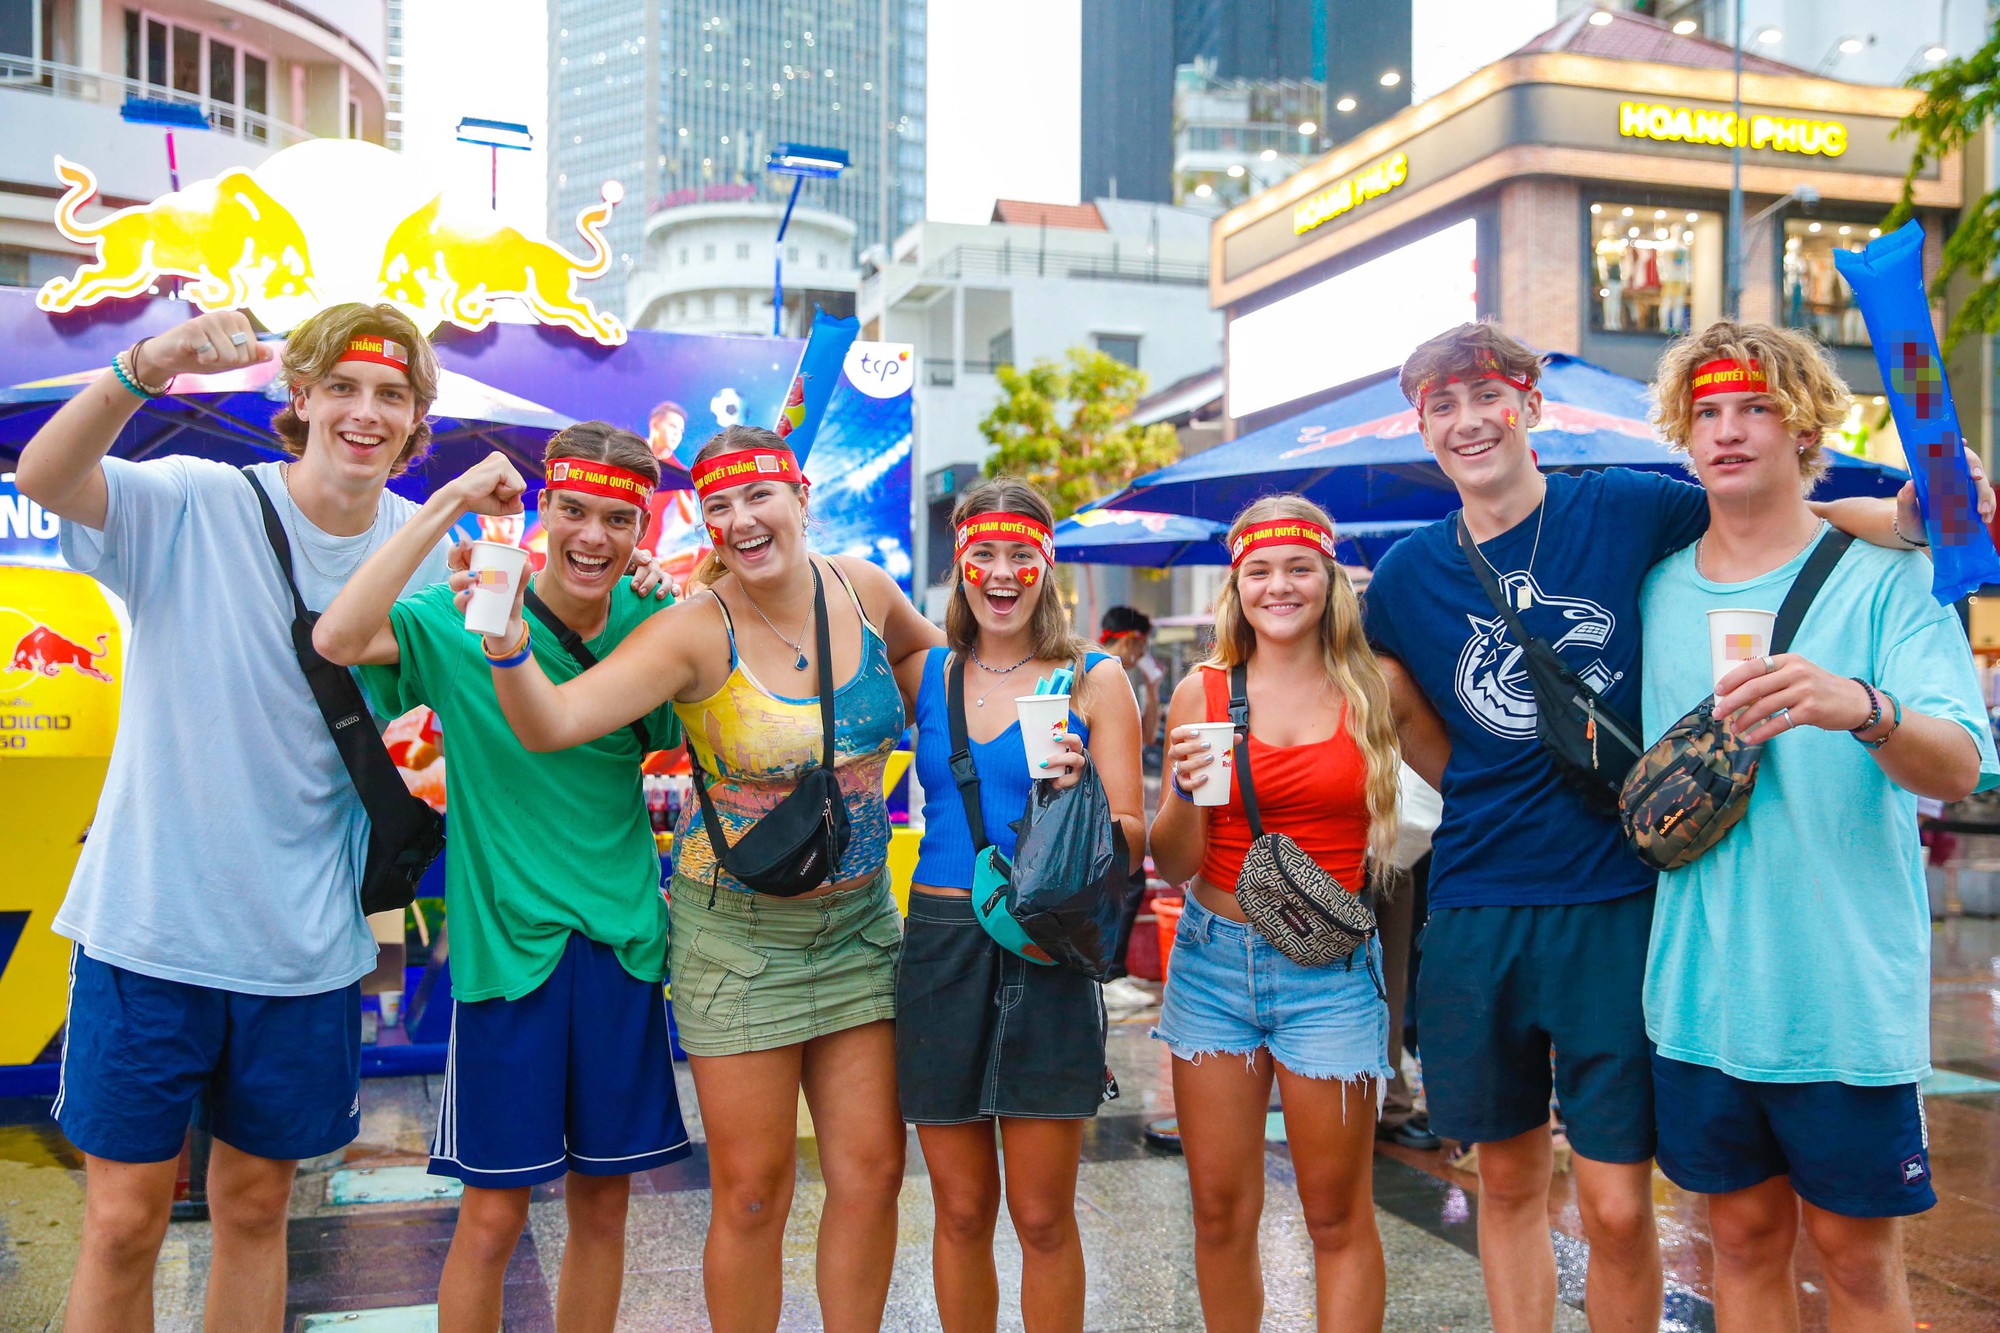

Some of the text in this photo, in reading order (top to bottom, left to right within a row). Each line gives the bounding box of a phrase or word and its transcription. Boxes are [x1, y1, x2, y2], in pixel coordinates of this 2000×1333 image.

[1750, 114, 1848, 157] PHUC
[350, 337, 383, 353] THẮNG
[860, 352, 899, 382] tcp
[1713, 368, 1745, 384] QUYẾT
[568, 467, 584, 481] VIỆT
[585, 471, 608, 485] NAM
[609, 476, 635, 492] QUYẾT
[703, 465, 726, 486] QUYẾT
[726, 459, 757, 476] THẮNG
[980, 521, 999, 532] NAM
[1000, 521, 1026, 535] QUYẾT
[1254, 527, 1274, 540] NAM
[1275, 524, 1301, 538] QUYẾT
[335, 715, 360, 730] OZUKO
[800, 850, 818, 876] EASTPAK
[1284, 909, 1307, 932] EASTPAK
